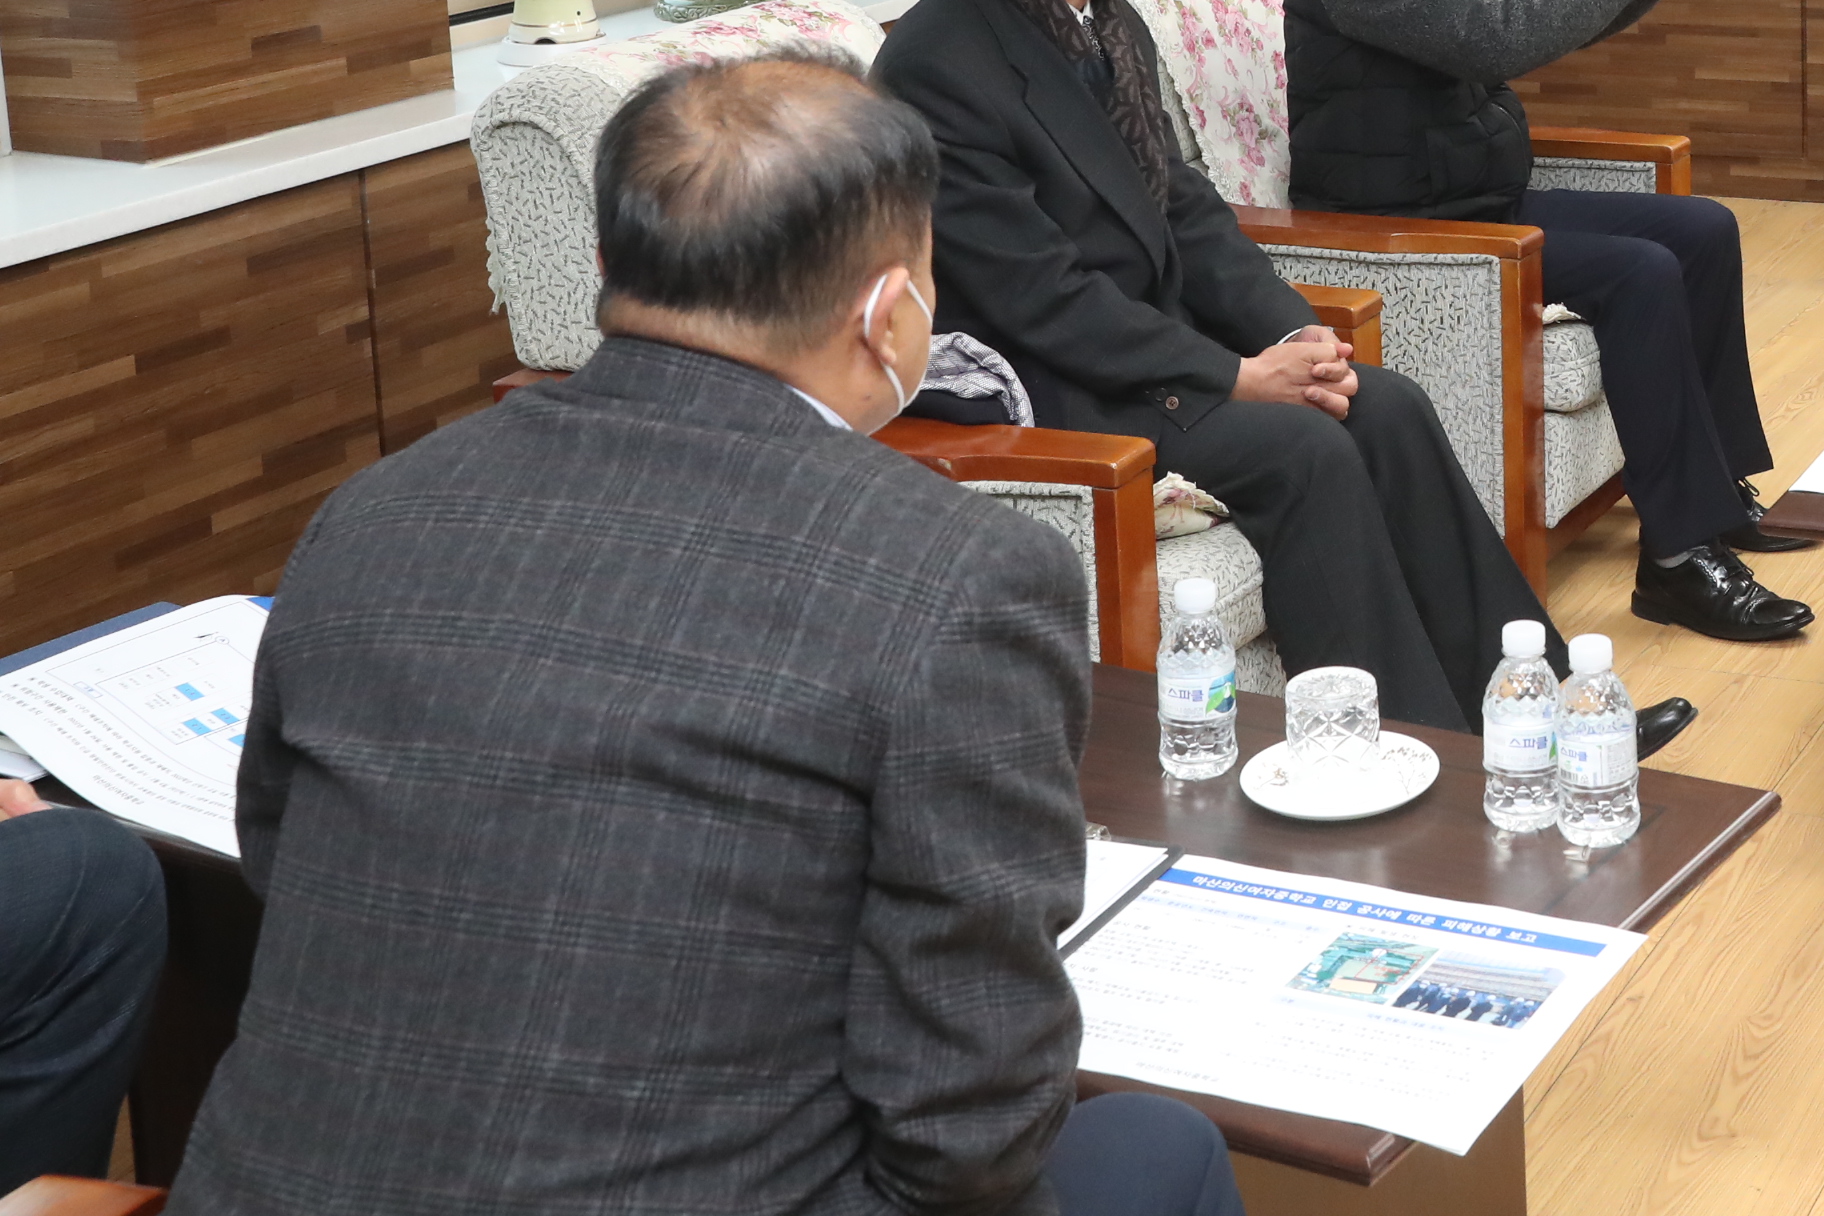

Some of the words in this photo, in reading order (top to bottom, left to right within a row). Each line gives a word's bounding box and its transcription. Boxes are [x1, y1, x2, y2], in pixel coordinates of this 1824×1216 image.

[1168, 687, 1203, 703] 스파클
[1508, 736, 1548, 750] 스파클
[1560, 748, 1588, 762] 스파클
[1192, 875, 1316, 906] 마산의신여자중학교
[1322, 897, 1353, 911] 인접
[1356, 902, 1401, 921] 공사에
[1406, 911, 1437, 926] 따른
[1441, 916, 1501, 939] 피해상황
[1506, 929, 1538, 944] 보고
